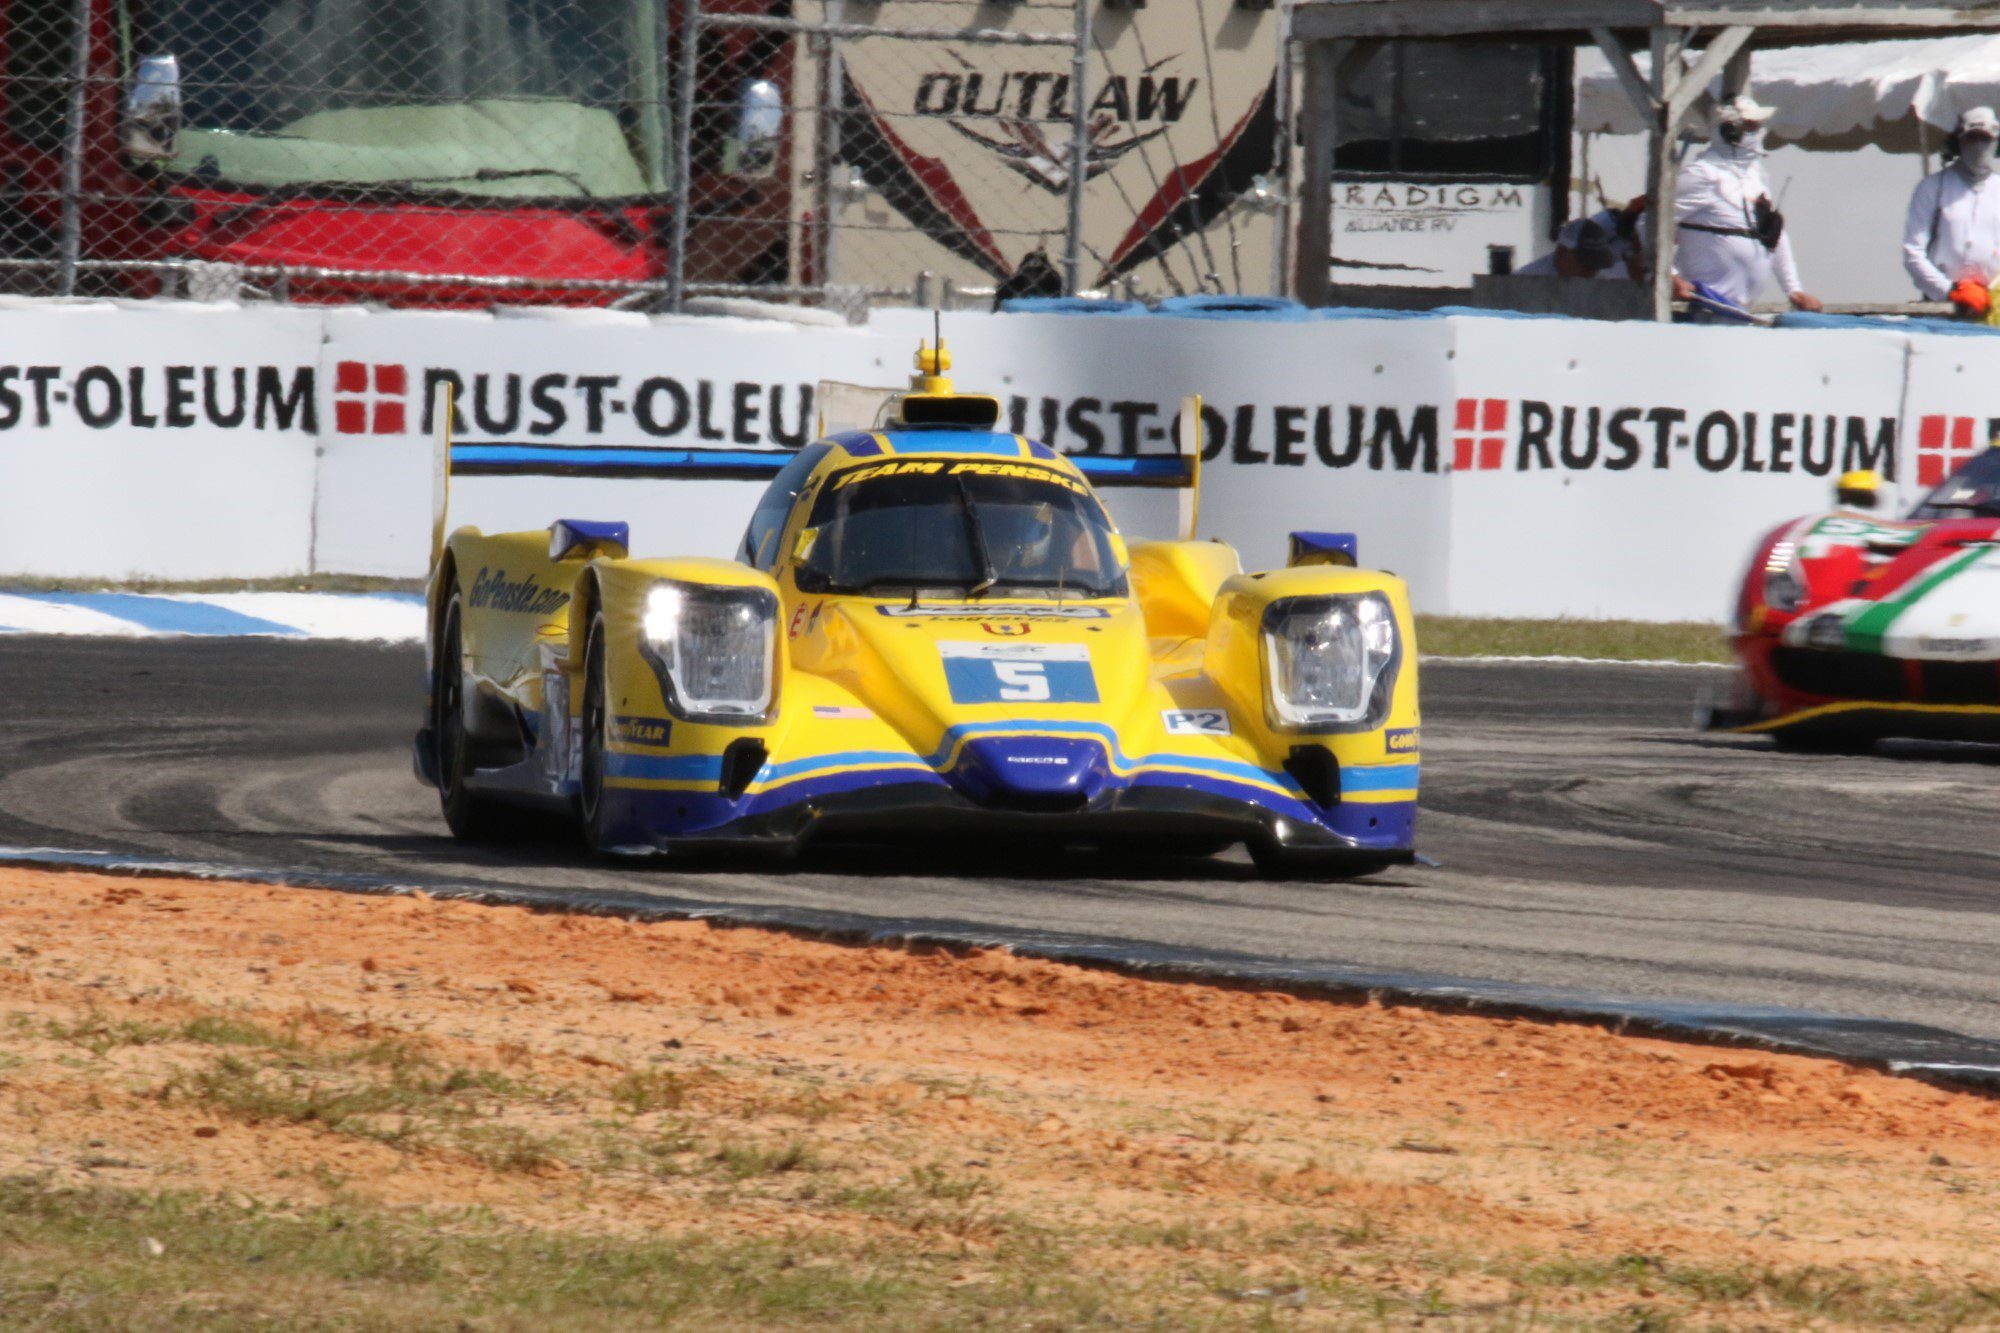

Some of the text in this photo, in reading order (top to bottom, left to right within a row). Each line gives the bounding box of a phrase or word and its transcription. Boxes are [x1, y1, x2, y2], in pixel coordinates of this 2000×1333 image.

[914, 71, 1198, 122] OUTLAW
[1330, 185, 1523, 208] RADIGM
[421, 367, 815, 449] RUST-OLEU
[1008, 395, 1439, 474] UST-OLEUM
[1515, 400, 1897, 483] RUST-OLEUM
[832, 461, 1090, 497] TEAM PENSKE
[992, 660, 1050, 700] 5
[1166, 713, 1225, 731] P2
